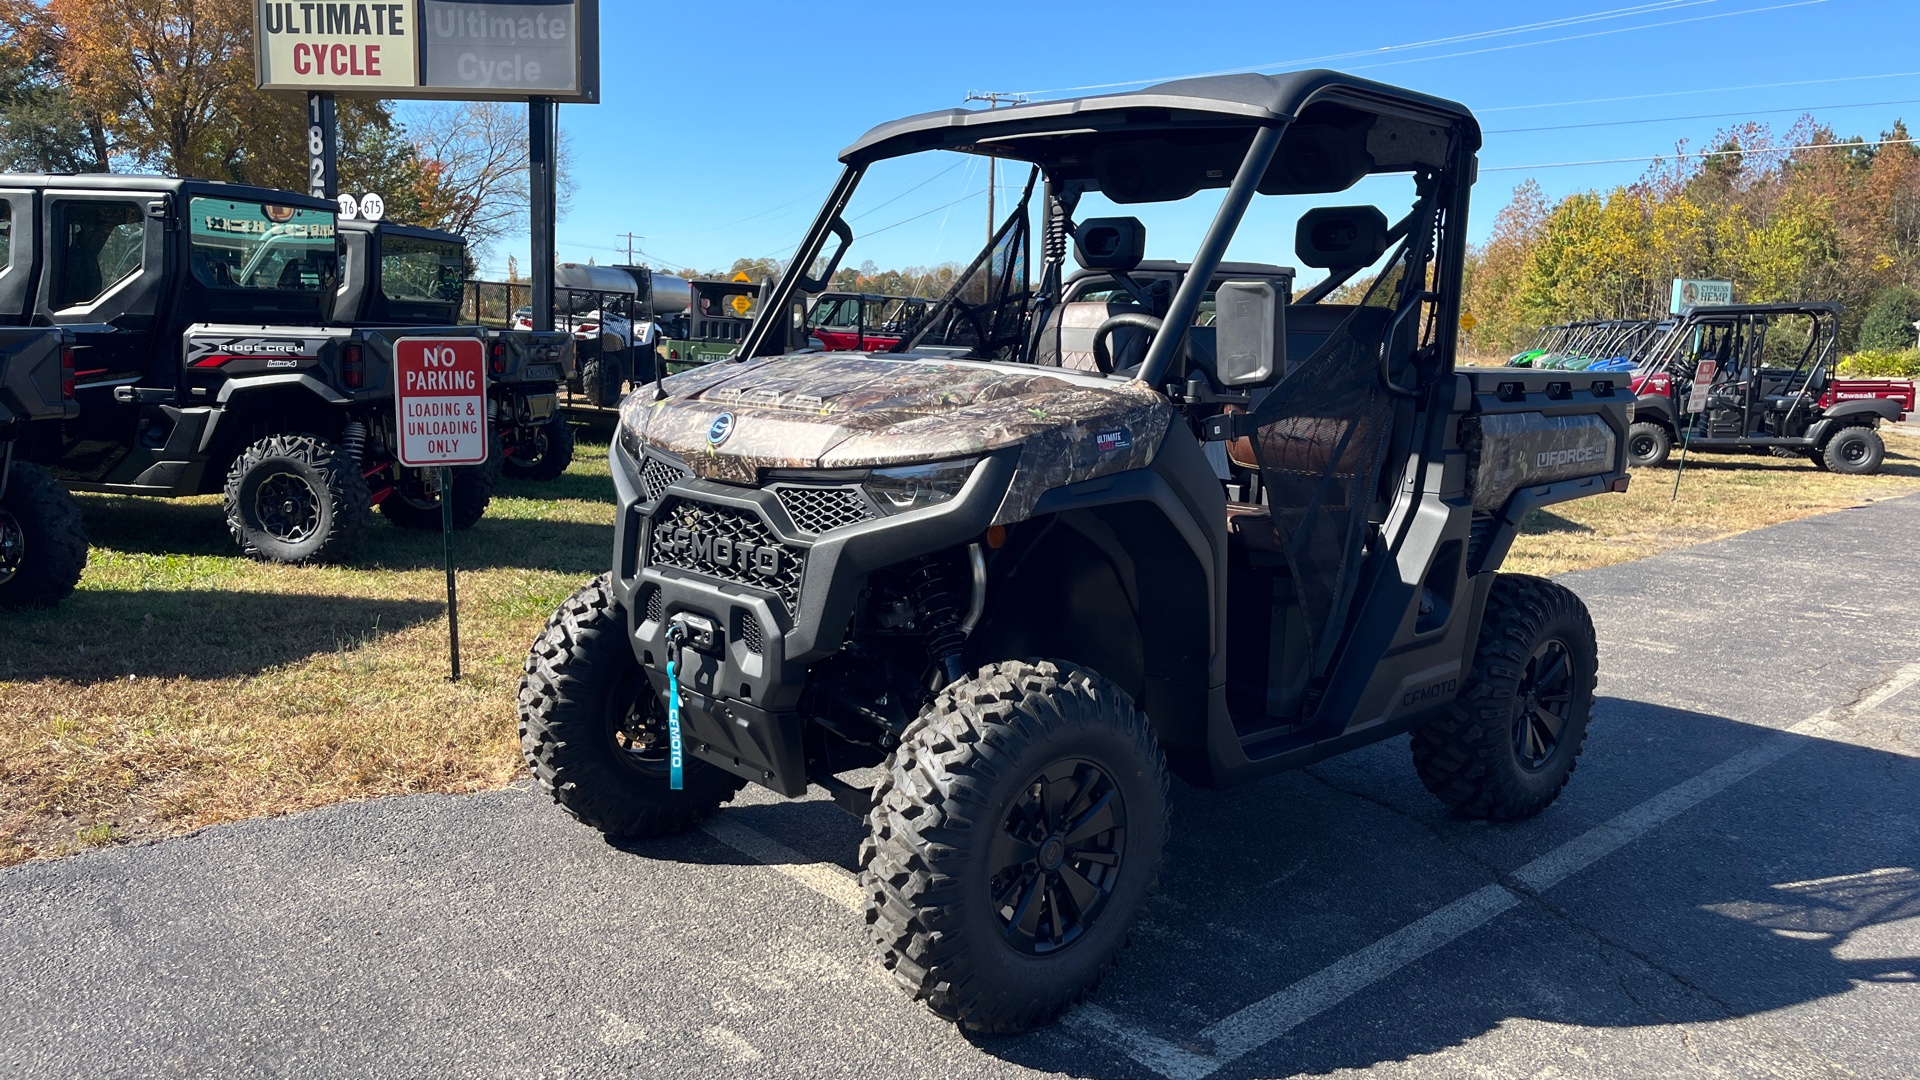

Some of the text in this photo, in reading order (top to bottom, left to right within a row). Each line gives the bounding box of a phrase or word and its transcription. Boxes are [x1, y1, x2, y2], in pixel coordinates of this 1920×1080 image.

[266, 3, 405, 36] ULTIMATE
[434, 6, 567, 40] Ultimate
[293, 43, 382, 76] CYCLE
[457, 53, 541, 86] Cycle
[364, 200, 381, 214] 675
[1701, 285, 1729, 293] CYPRESS
[1701, 292, 1728, 301] HEMP
[219, 344, 261, 352] RIDGE
[423, 347, 456, 368] NO
[406, 370, 476, 390] PARKING
[408, 402, 475, 417] LOADING &
[408, 421, 477, 436] UNLOADING
[1097, 432, 1121, 443] ULTIMATE
[428, 439, 459, 453] ONLY
[660, 524, 778, 575] CFMOTO
[1402, 678, 1456, 706] CFMOTO
[669, 708, 682, 768] CFMOTO
